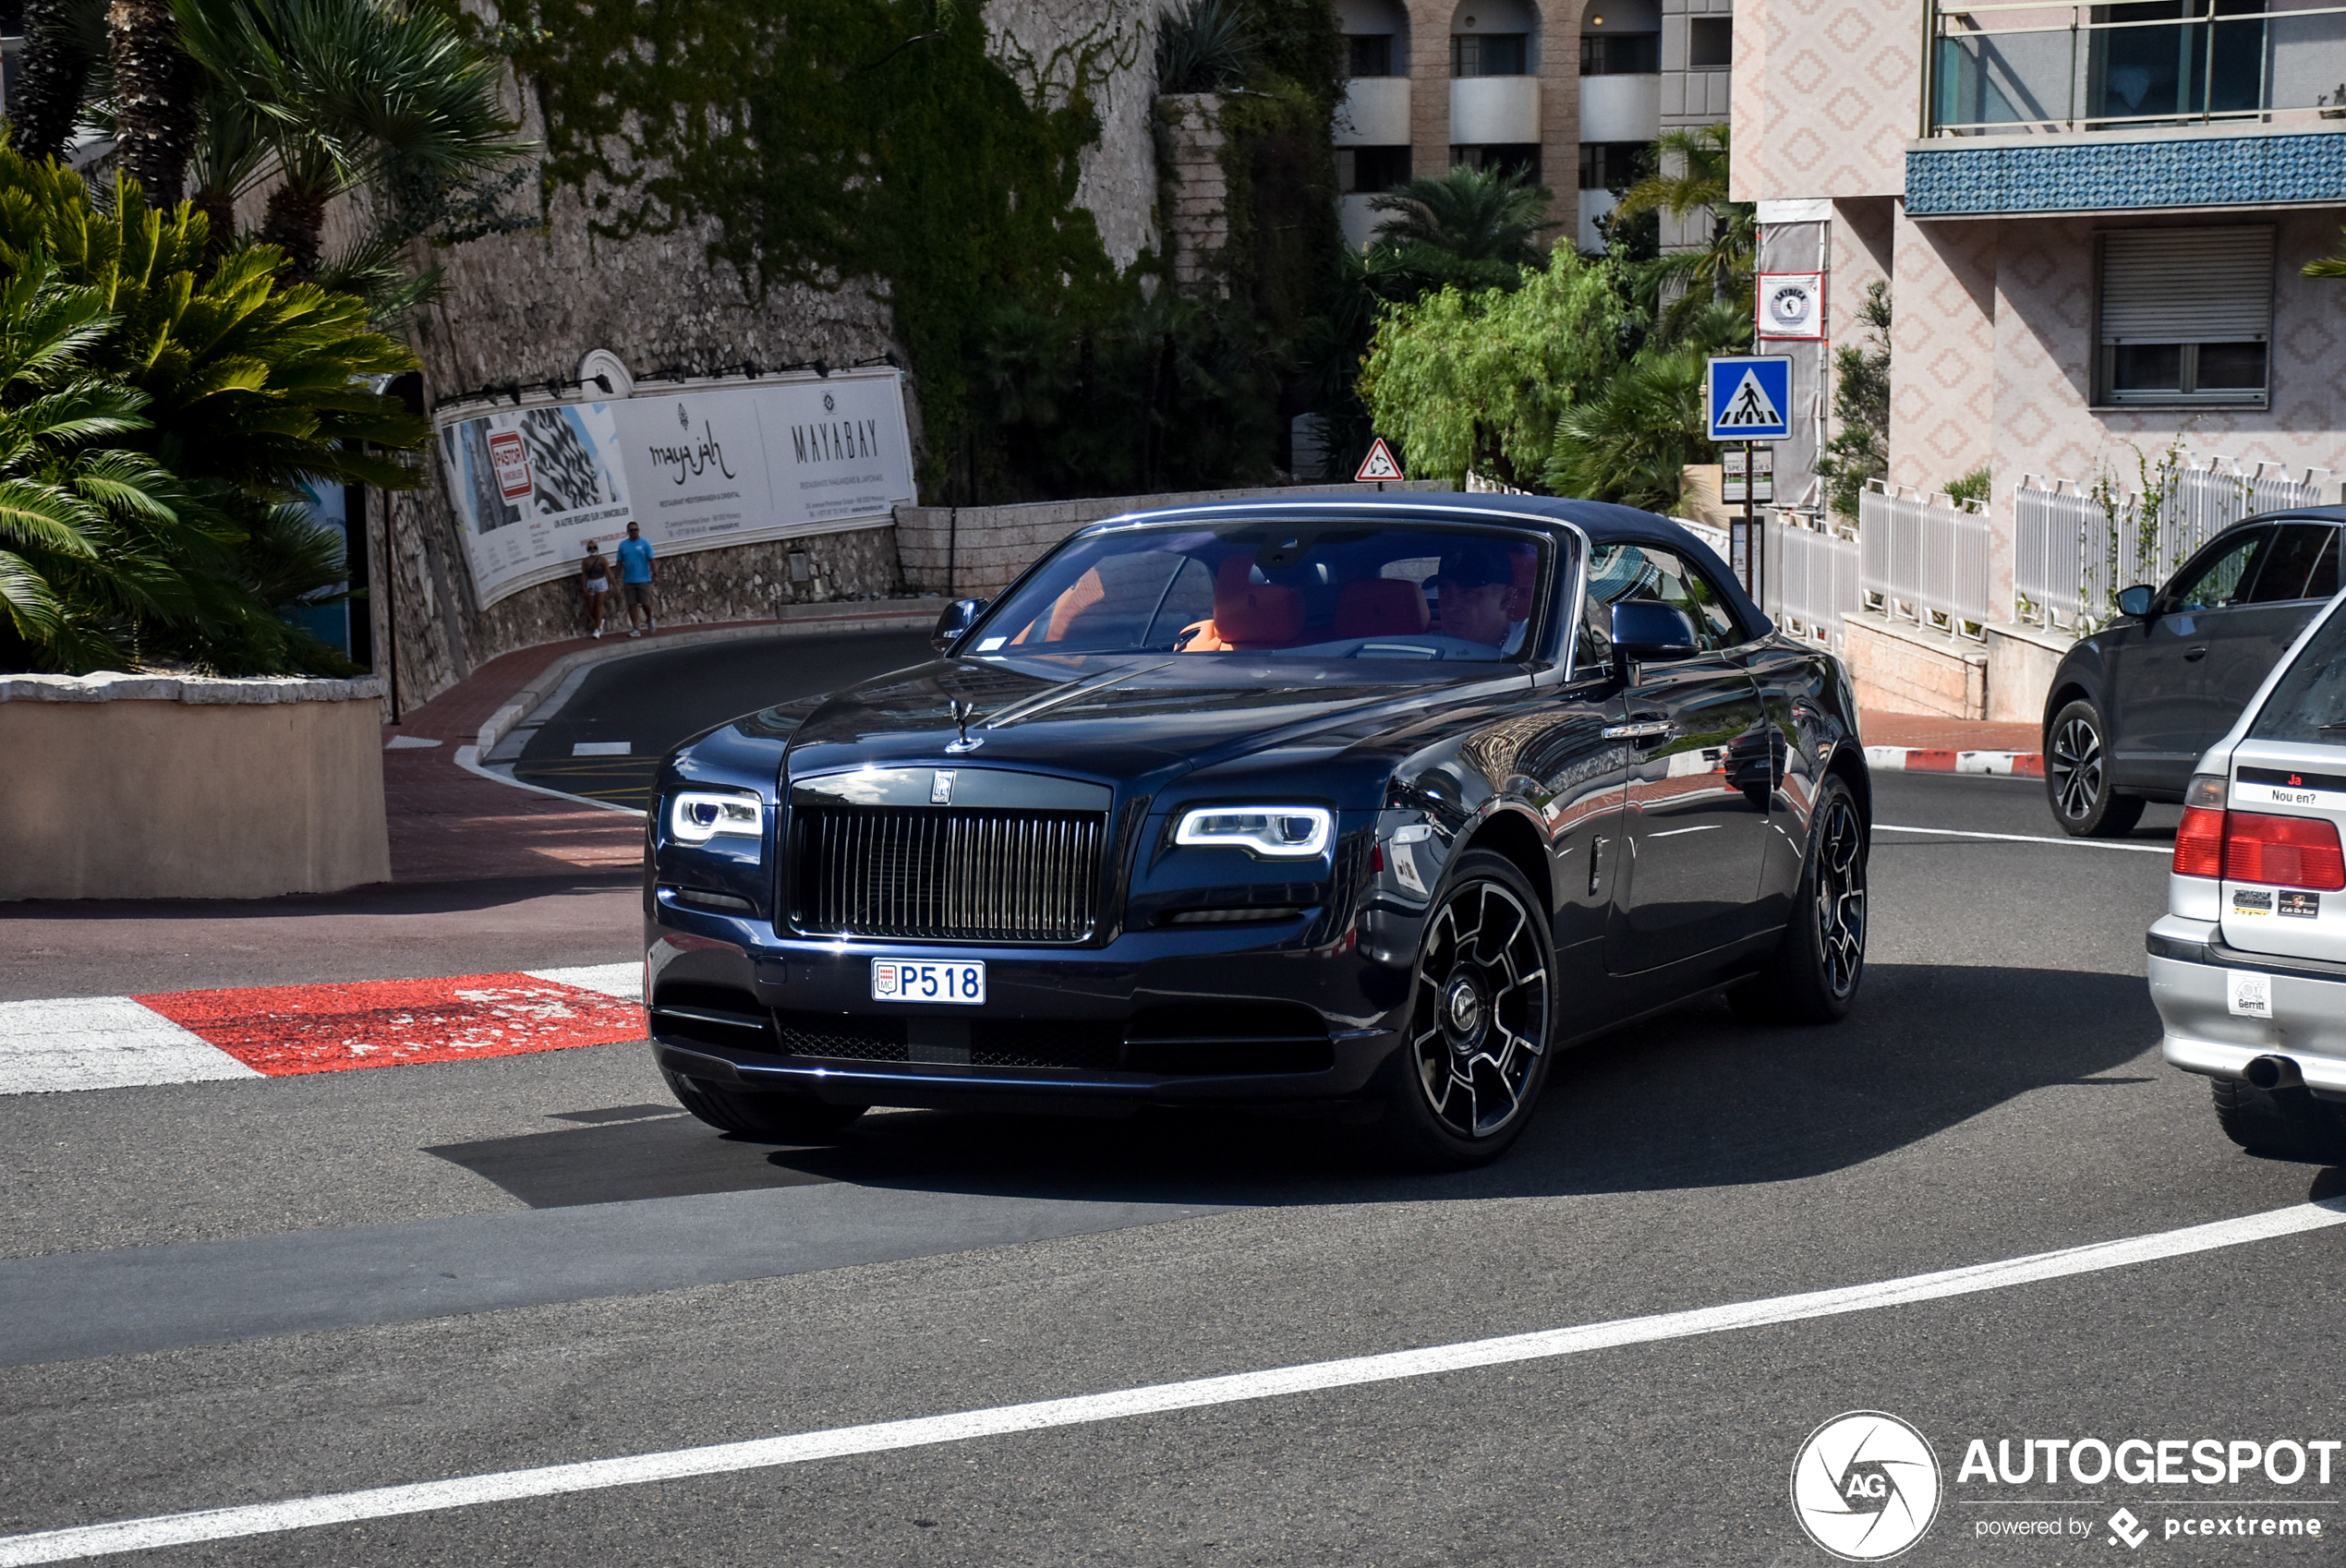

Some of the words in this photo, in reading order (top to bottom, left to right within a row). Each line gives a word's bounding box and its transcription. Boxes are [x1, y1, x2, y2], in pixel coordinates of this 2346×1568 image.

[1774, 288, 1807, 301] SKYDECK
[792, 419, 877, 464] MAYABAY
[495, 448, 523, 467] PASTOR
[2288, 774, 2302, 786] Ja
[2272, 790, 2292, 802] Nou
[2296, 793, 2316, 804] en?
[880, 981, 893, 990] MC
[901, 966, 979, 998] P518
